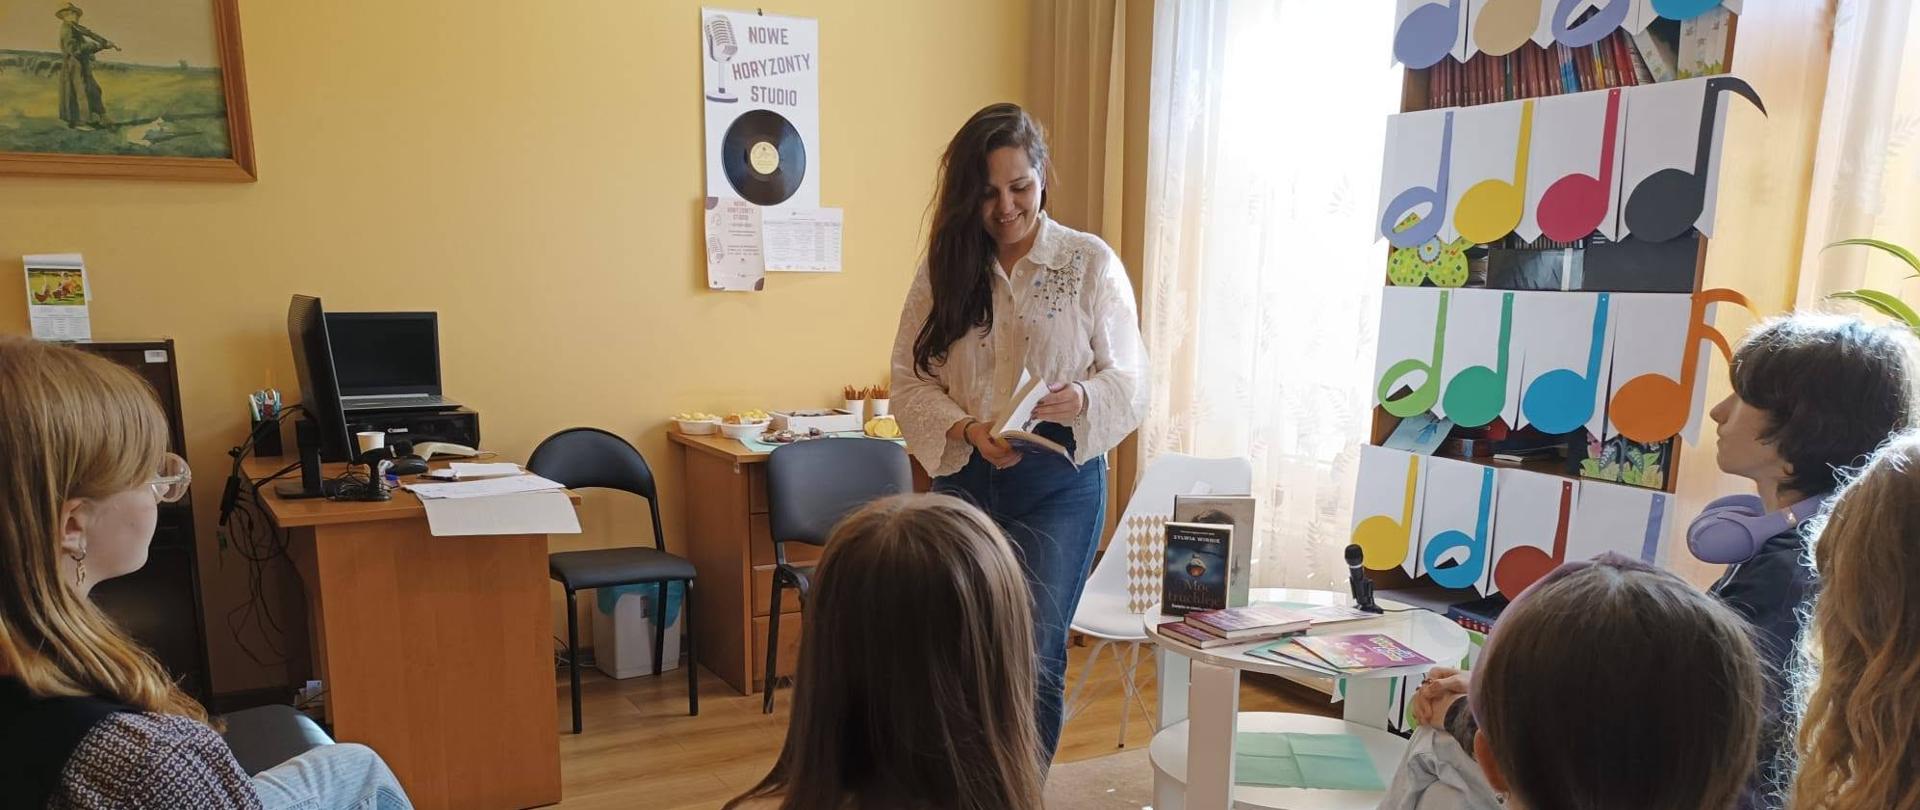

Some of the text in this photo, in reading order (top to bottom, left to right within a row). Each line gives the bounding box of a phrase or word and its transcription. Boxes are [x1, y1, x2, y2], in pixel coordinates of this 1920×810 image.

[748, 26, 789, 45] NOWE
[732, 53, 810, 80] HORYZONTY
[751, 85, 797, 106] STUDIO
